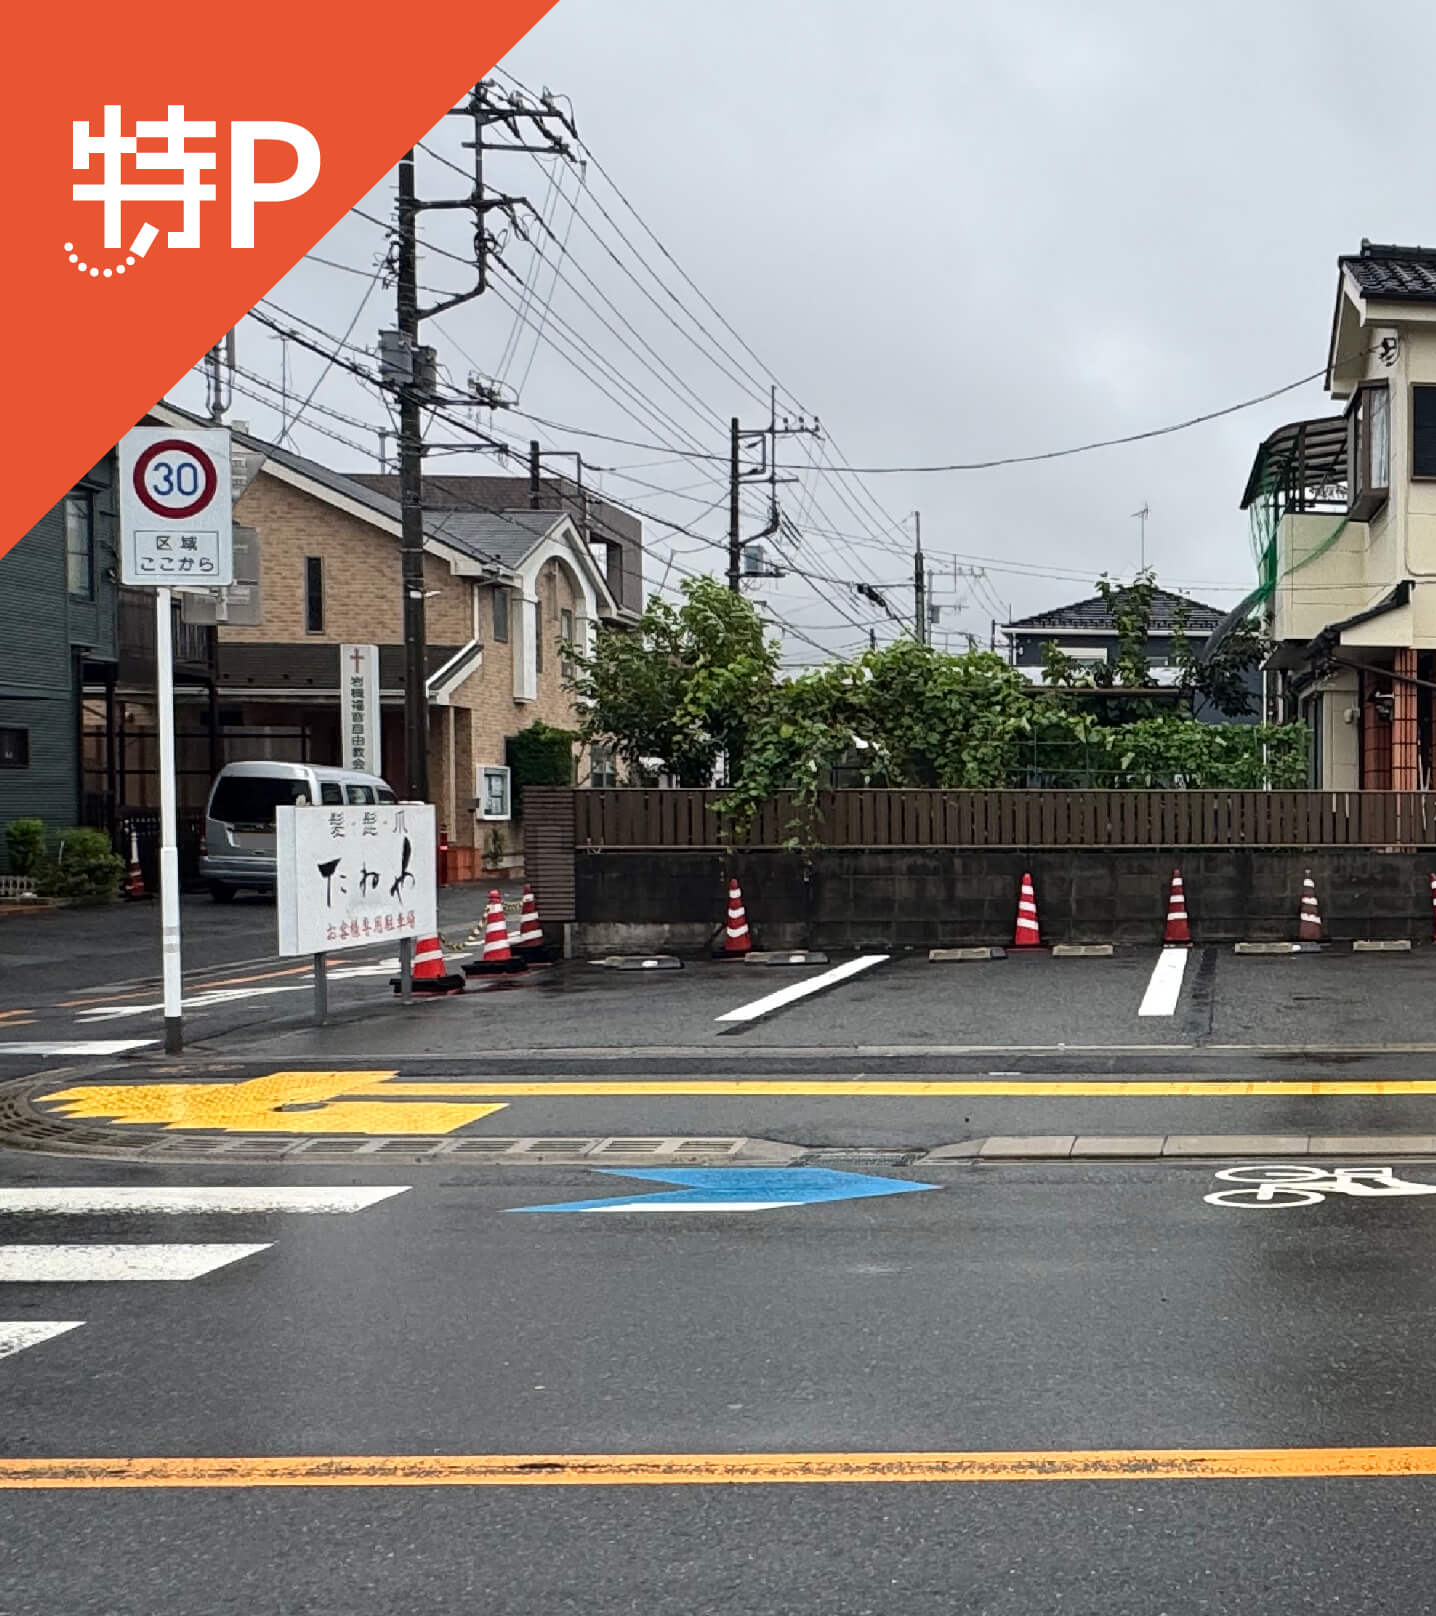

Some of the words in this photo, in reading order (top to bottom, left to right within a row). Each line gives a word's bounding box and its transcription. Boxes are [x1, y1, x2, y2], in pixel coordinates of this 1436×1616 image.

[152, 462, 199, 496] 30
[156, 535, 198, 551] 区域
[140, 556, 214, 572] ここから
